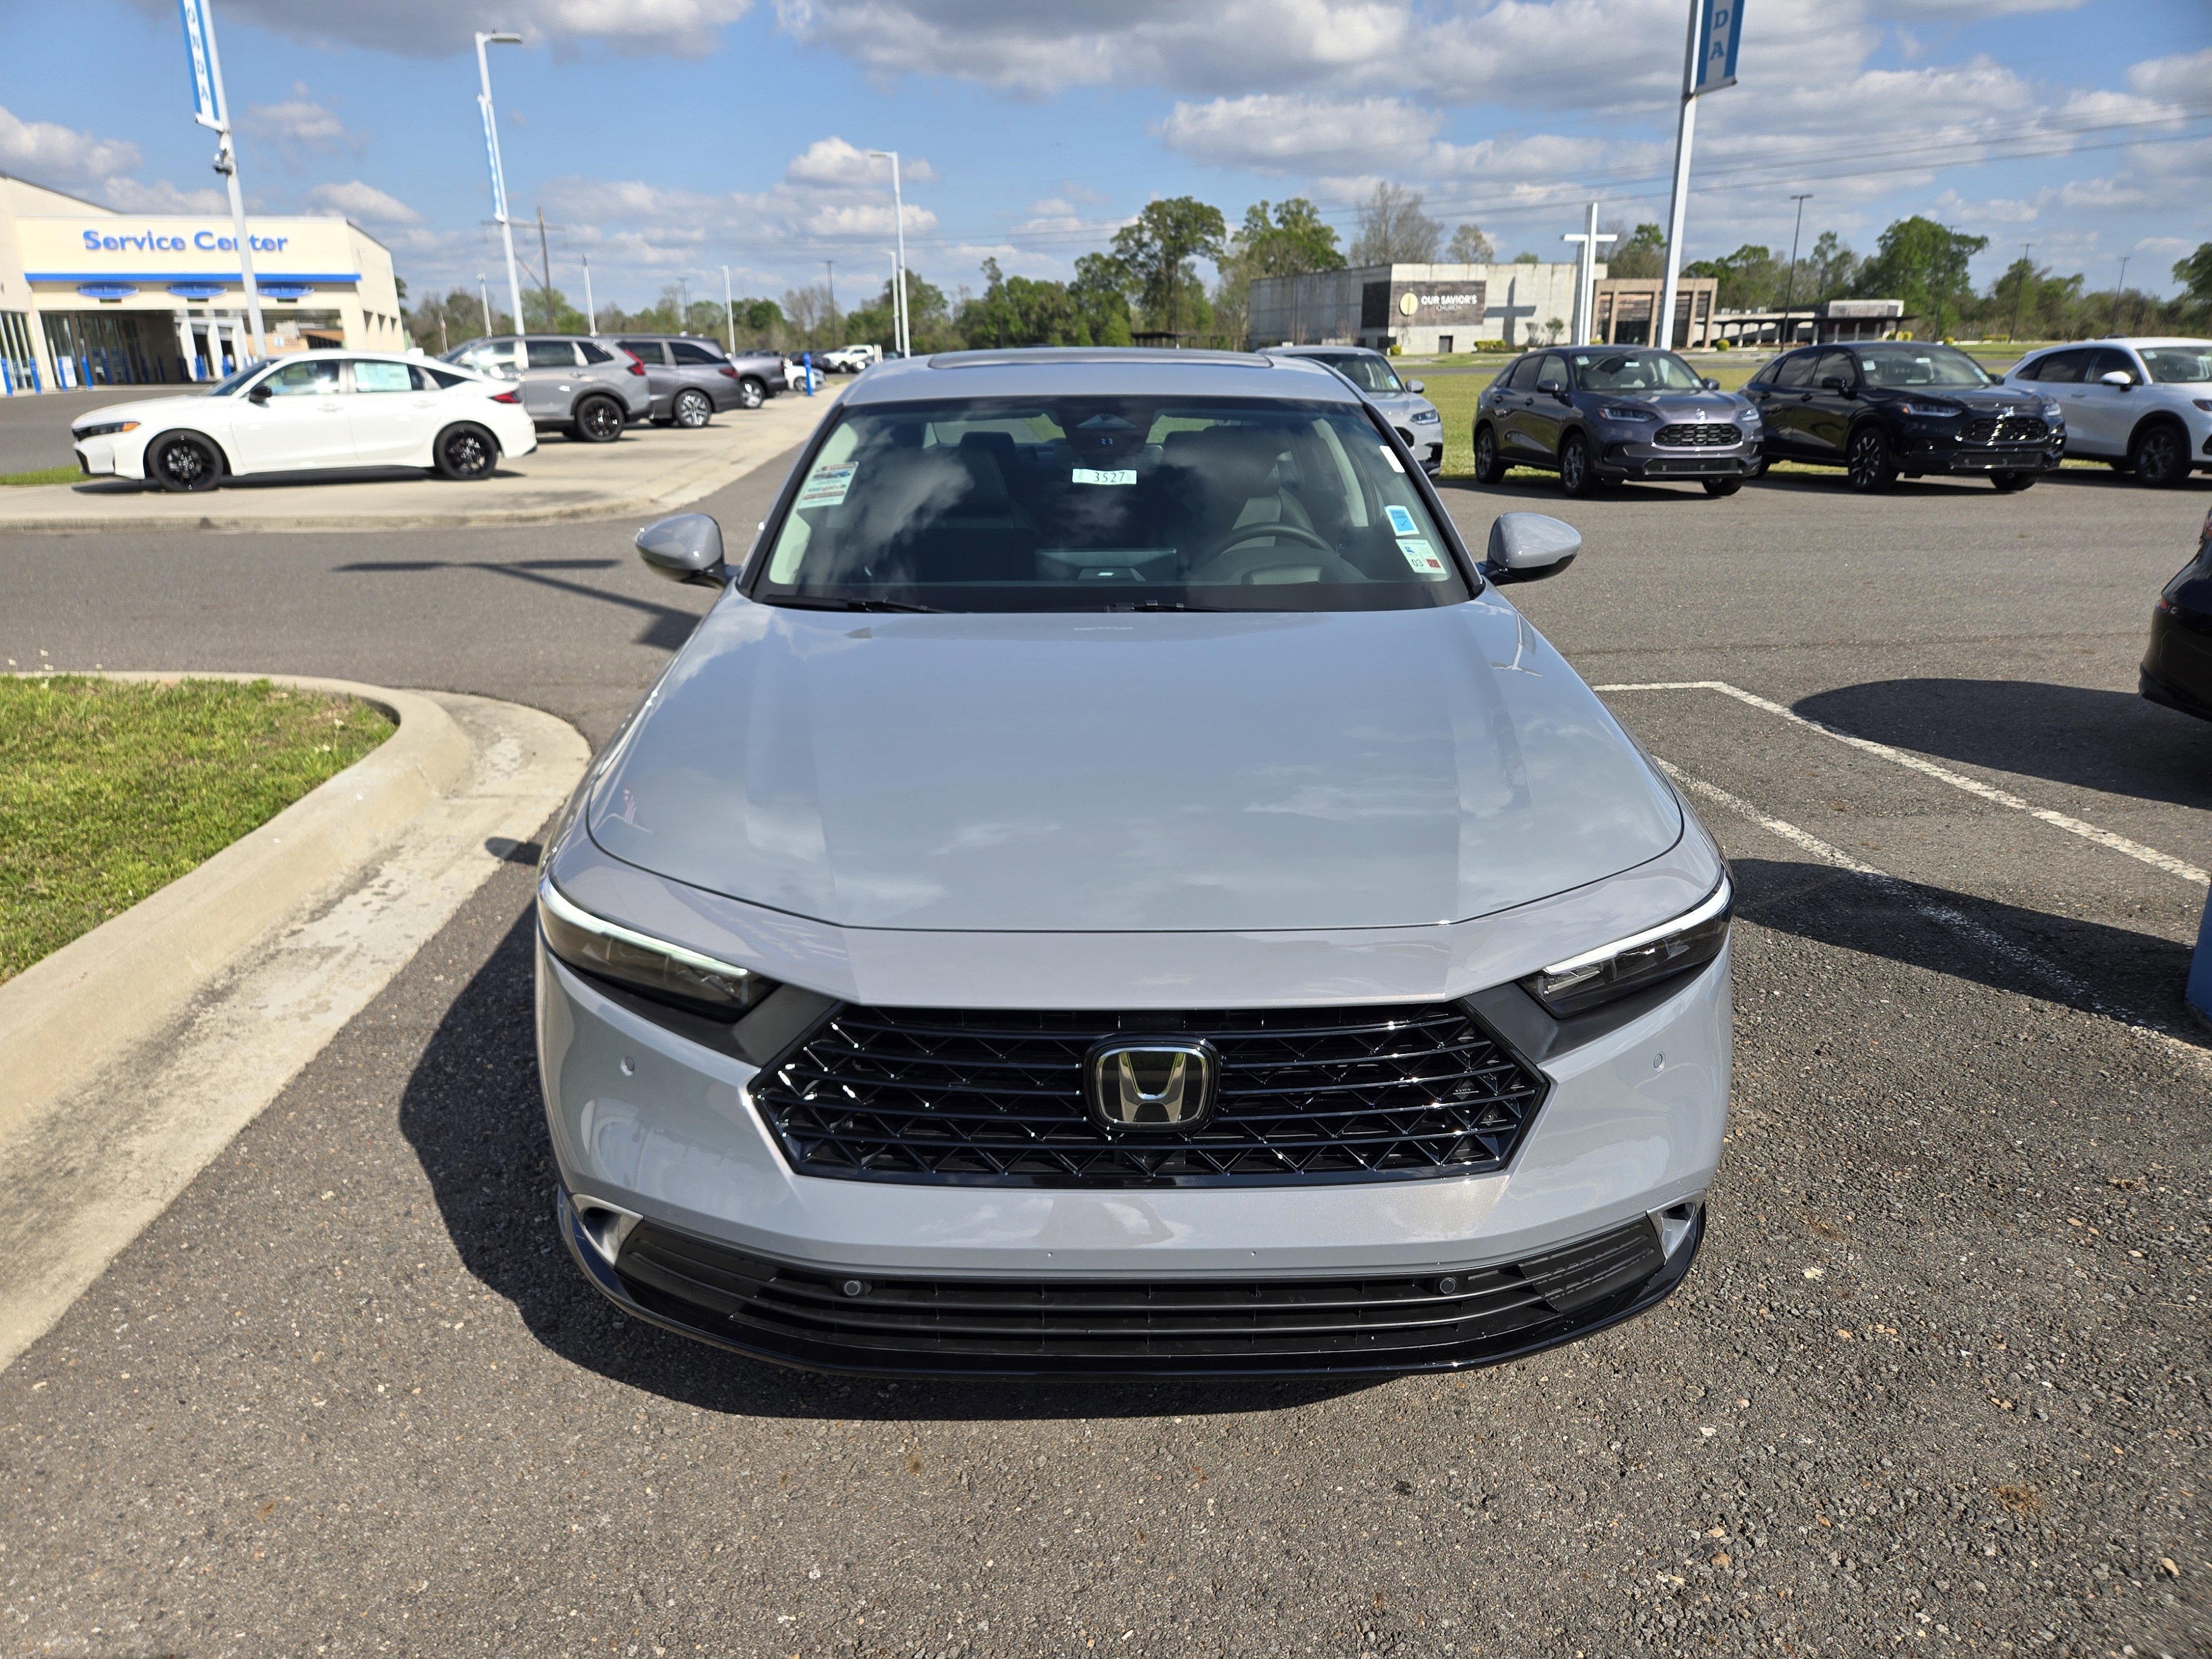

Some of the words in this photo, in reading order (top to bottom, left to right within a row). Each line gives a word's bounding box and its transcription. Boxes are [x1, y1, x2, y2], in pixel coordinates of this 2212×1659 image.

[82, 230, 186, 251] Service
[1421, 295, 1440, 305] OUR
[1441, 295, 1478, 305] SAVIOR'S
[1094, 472, 1125, 482] 3527
[1411, 559, 1424, 567] 03
